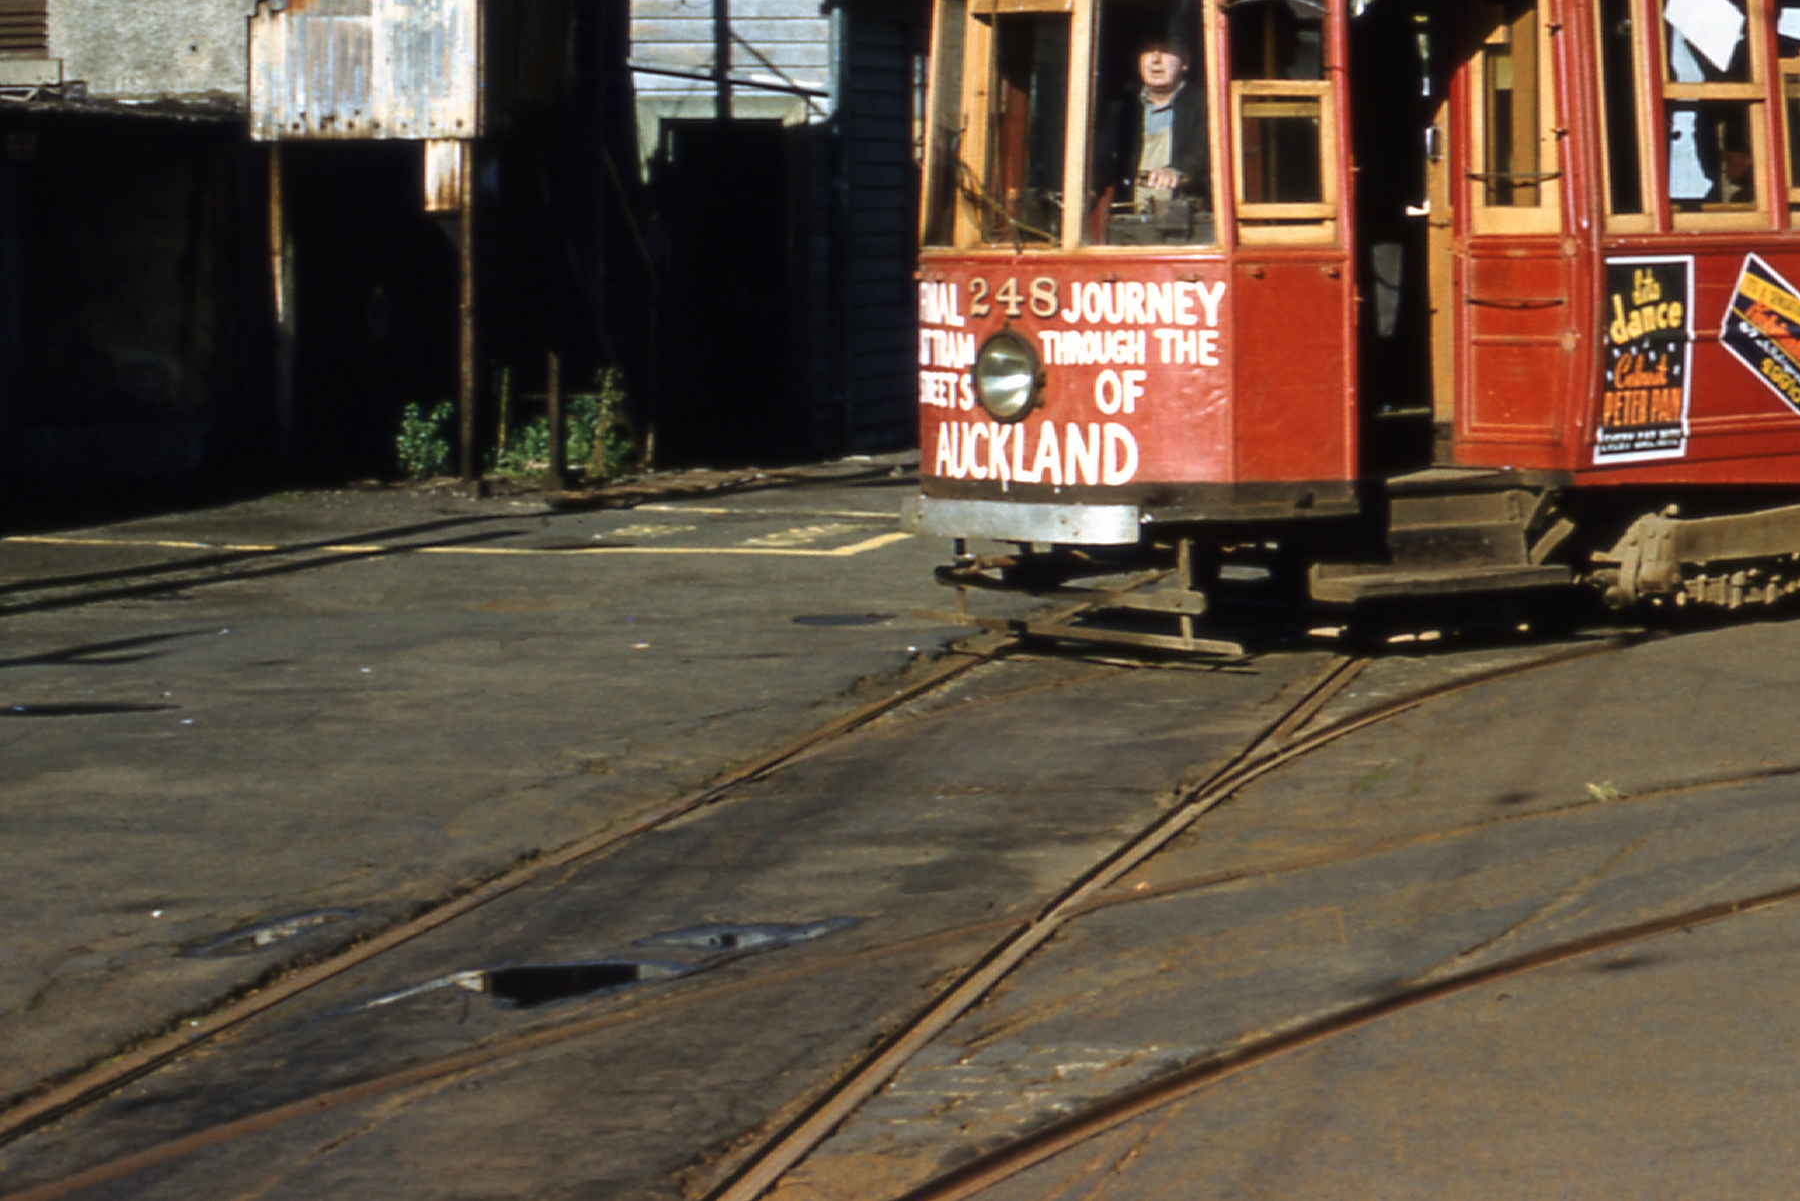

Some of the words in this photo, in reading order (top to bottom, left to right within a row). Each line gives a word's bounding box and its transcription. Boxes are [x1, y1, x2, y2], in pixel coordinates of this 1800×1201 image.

[968, 277, 1059, 318] 248
[1061, 281, 1226, 327] JOURNEY
[1038, 330, 1146, 365] THROUGH
[1154, 329, 1219, 366] THE
[1094, 369, 1147, 415] OF
[935, 420, 1139, 487] AUCKLAND
